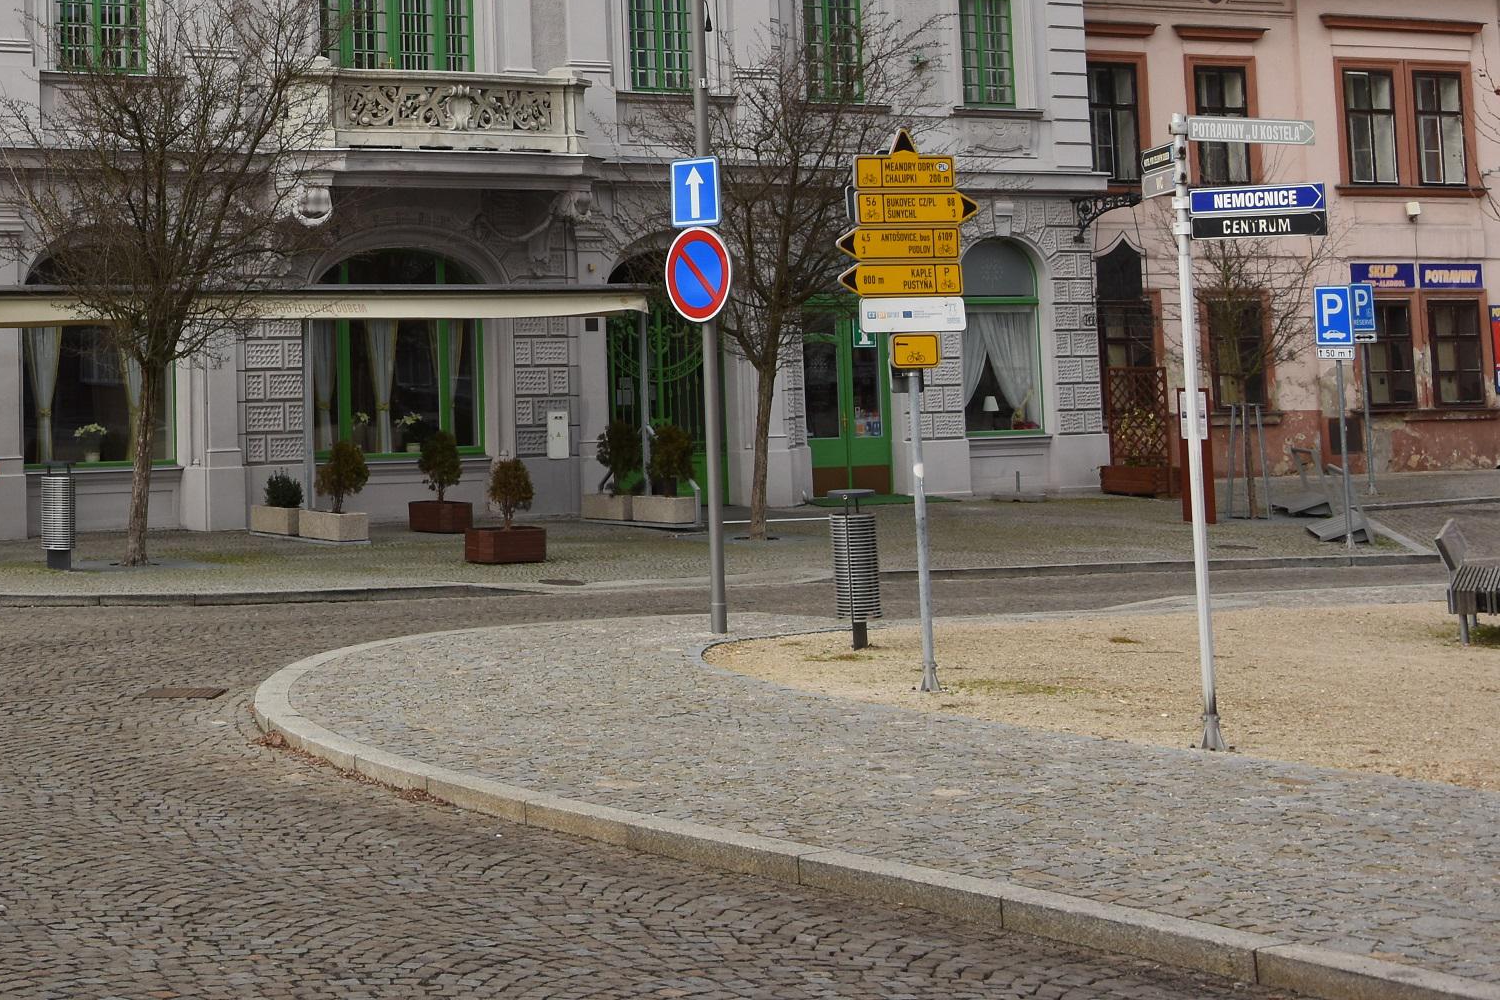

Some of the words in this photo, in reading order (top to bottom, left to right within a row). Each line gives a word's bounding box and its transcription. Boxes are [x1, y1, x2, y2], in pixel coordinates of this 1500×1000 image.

[1192, 122, 1244, 140] POTRAVINY
[884, 162, 916, 172] MEANDRY
[917, 162, 935, 172] ODRY
[929, 174, 942, 183] 200
[866, 197, 877, 206] 56
[886, 198, 916, 207] BUKOVEC
[918, 198, 936, 207] CZ/PL
[1213, 190, 1297, 209] NEMOCNICE
[887, 208, 917, 218] ŠUNYCHL
[951, 208, 956, 218] 3
[1222, 218, 1291, 234] CENTRUM
[919, 233, 931, 241] bus
[937, 232, 953, 241] 6109
[910, 268, 932, 278] KAPLE
[943, 267, 950, 277] P
[1424, 269, 1478, 283] POTRAVINY
[1354, 289, 1369, 316] P
[1321, 293, 1343, 327] P
[1325, 349, 1335, 357] 50
